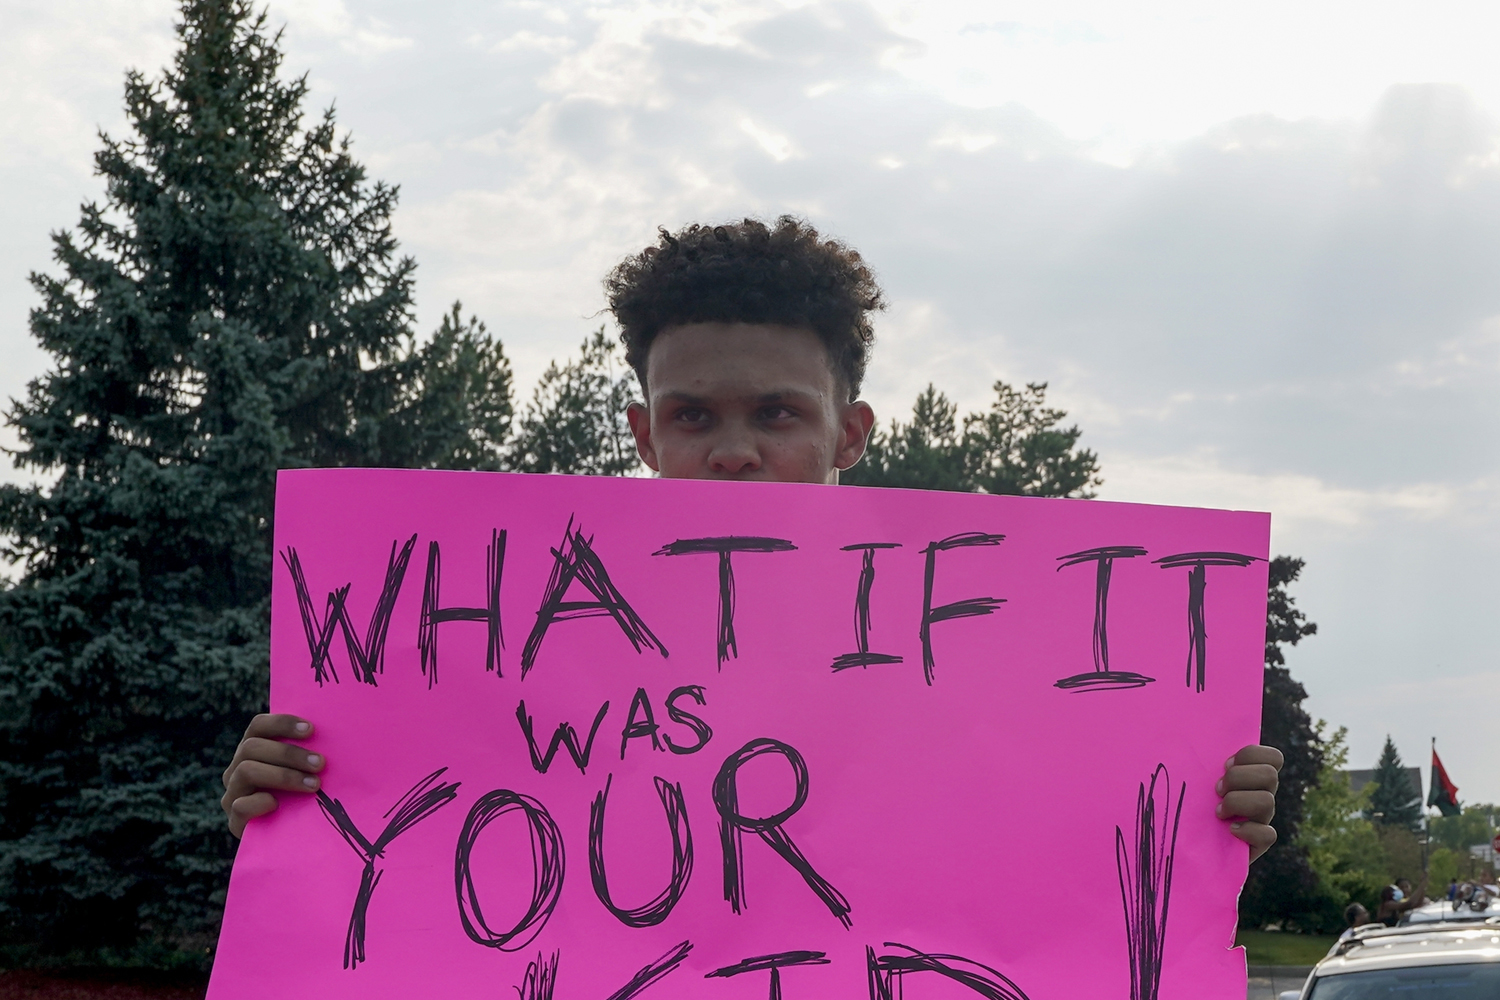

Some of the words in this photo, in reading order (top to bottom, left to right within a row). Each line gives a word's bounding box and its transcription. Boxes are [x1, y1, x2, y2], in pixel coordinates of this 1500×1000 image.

[279, 512, 799, 688] WHAT
[831, 531, 1007, 687] IF
[1053, 545, 1268, 694] IT
[515, 684, 715, 775] WAS
[316, 736, 852, 970] YOUR
